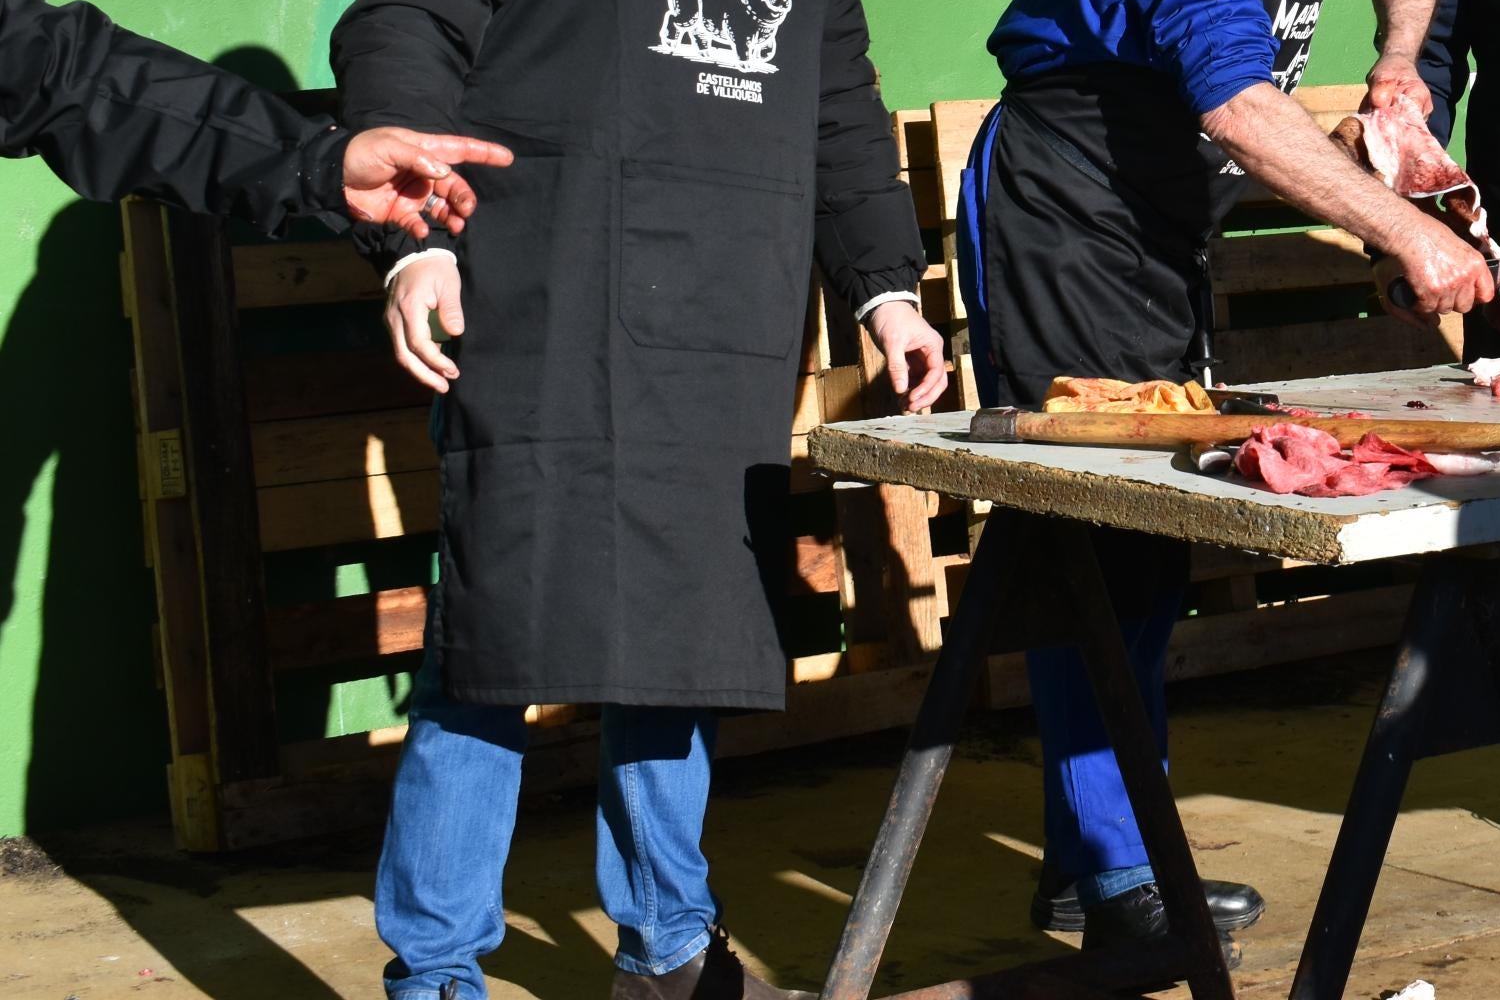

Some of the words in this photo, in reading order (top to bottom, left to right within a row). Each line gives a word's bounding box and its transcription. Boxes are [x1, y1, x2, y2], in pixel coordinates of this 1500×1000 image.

[696, 82, 710, 95] DE
[712, 85, 763, 104] VILLIQUERA
[698, 72, 762, 93] CASTELLANOS
